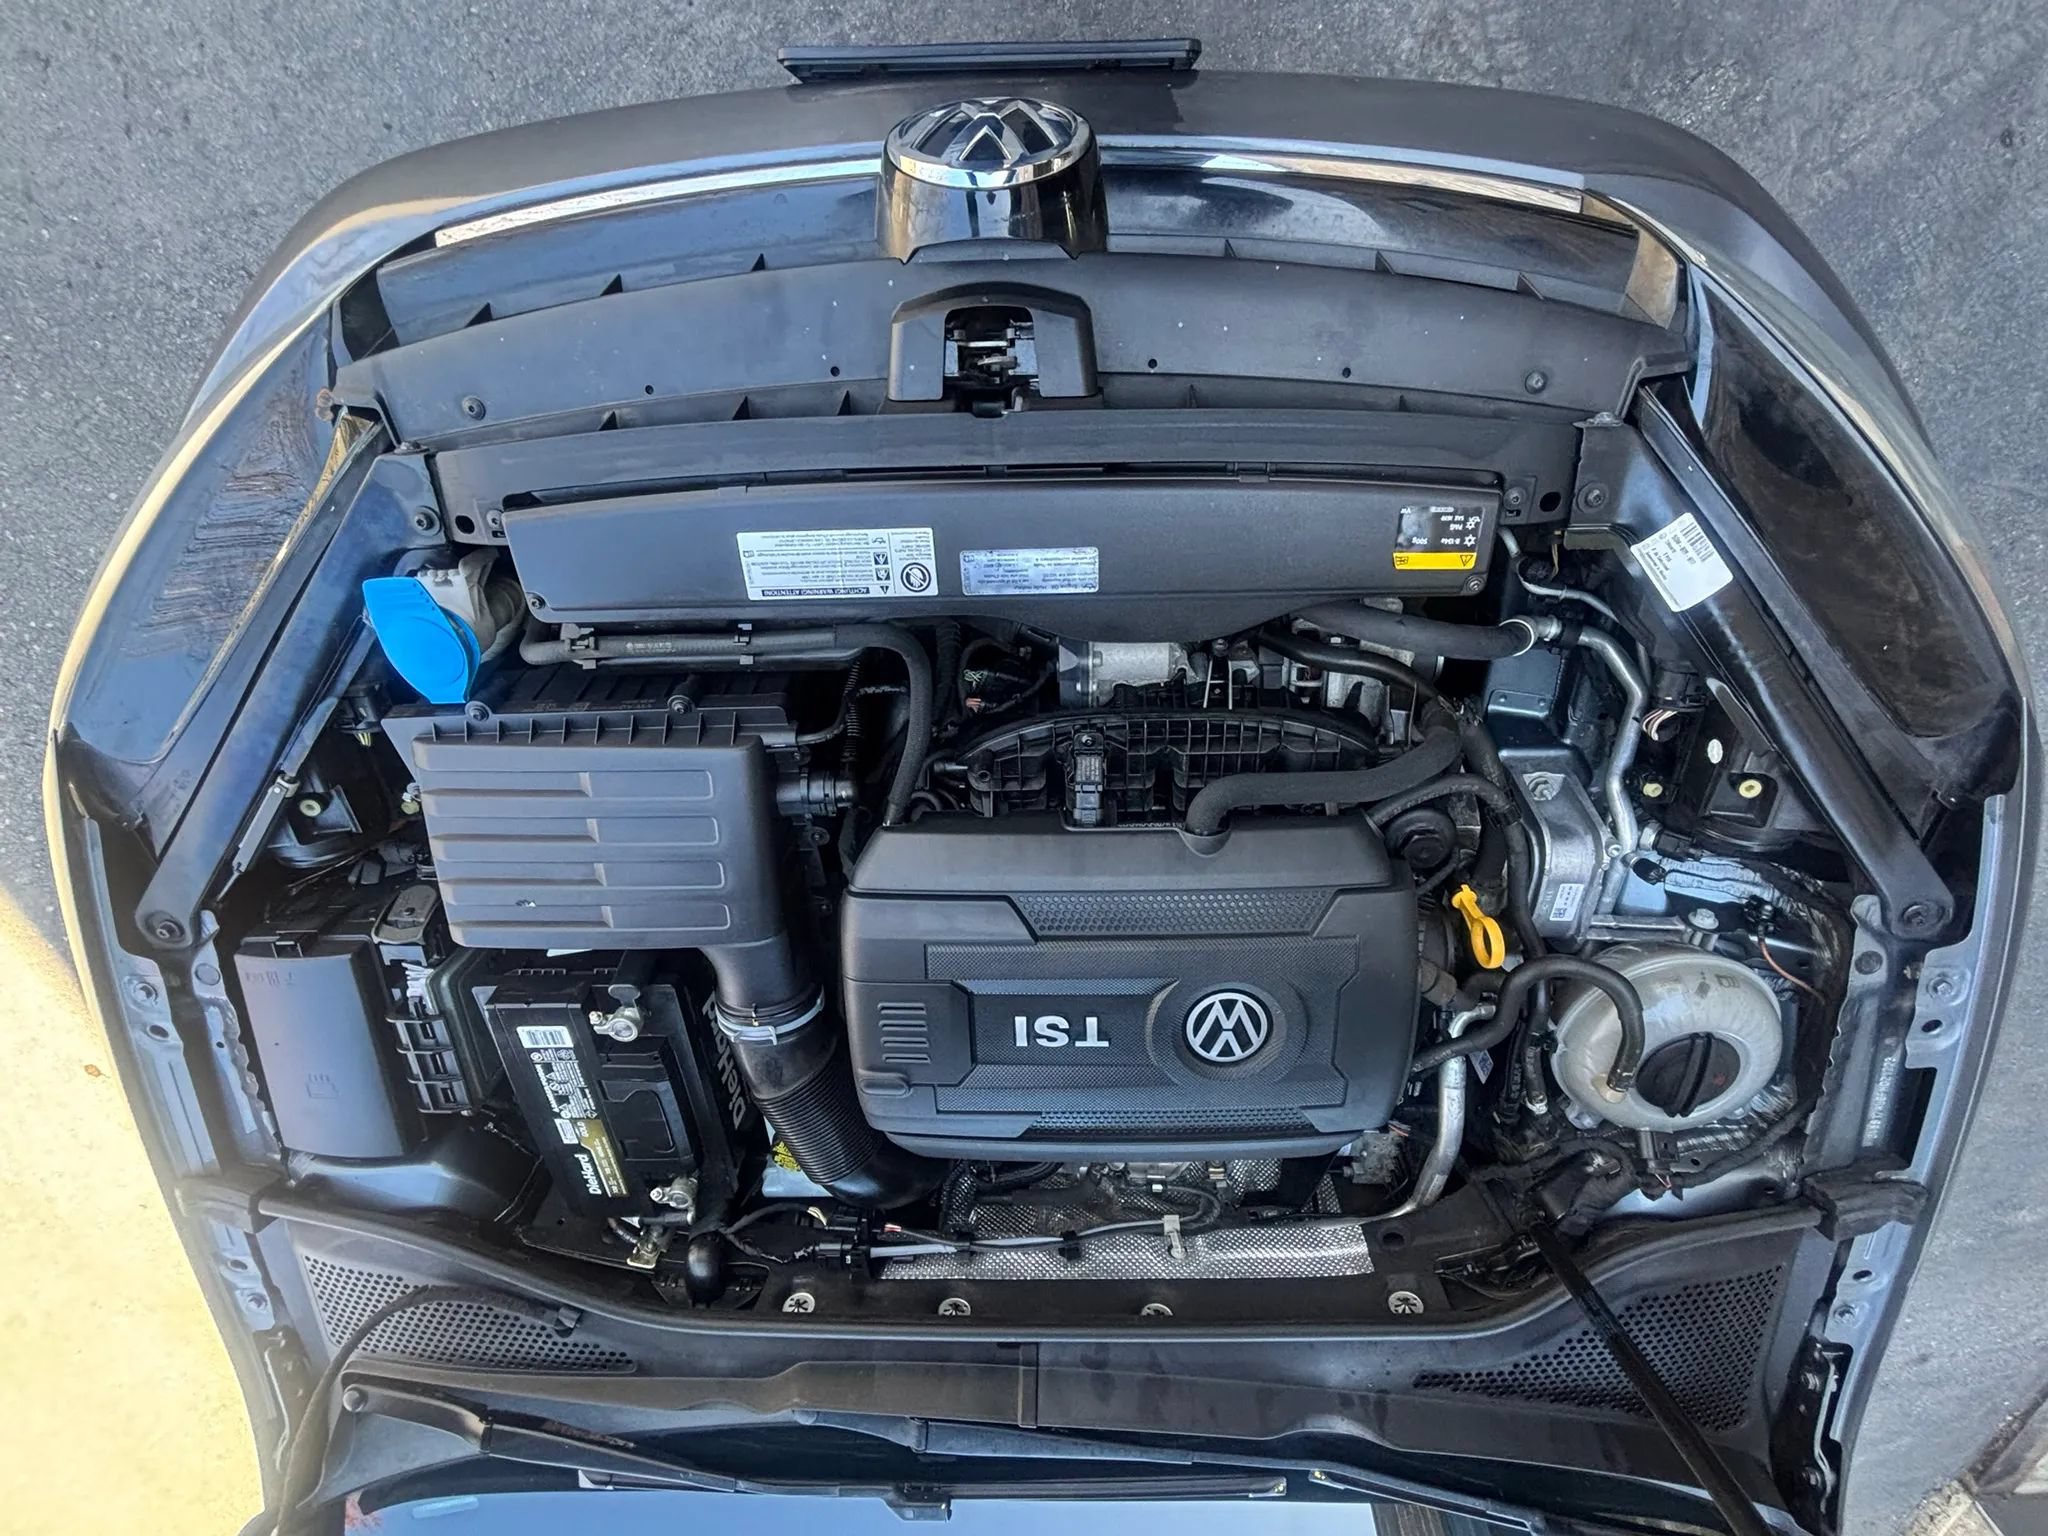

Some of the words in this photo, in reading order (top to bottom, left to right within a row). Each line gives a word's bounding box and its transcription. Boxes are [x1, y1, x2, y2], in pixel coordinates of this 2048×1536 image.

[802, 587, 833, 595] WARNING!
[834, 586, 866, 594] ACHTUNG!
[1013, 1014, 1109, 1048] TSI
[701, 995, 747, 1130] DieHard
[573, 1153, 602, 1196] DieHard
